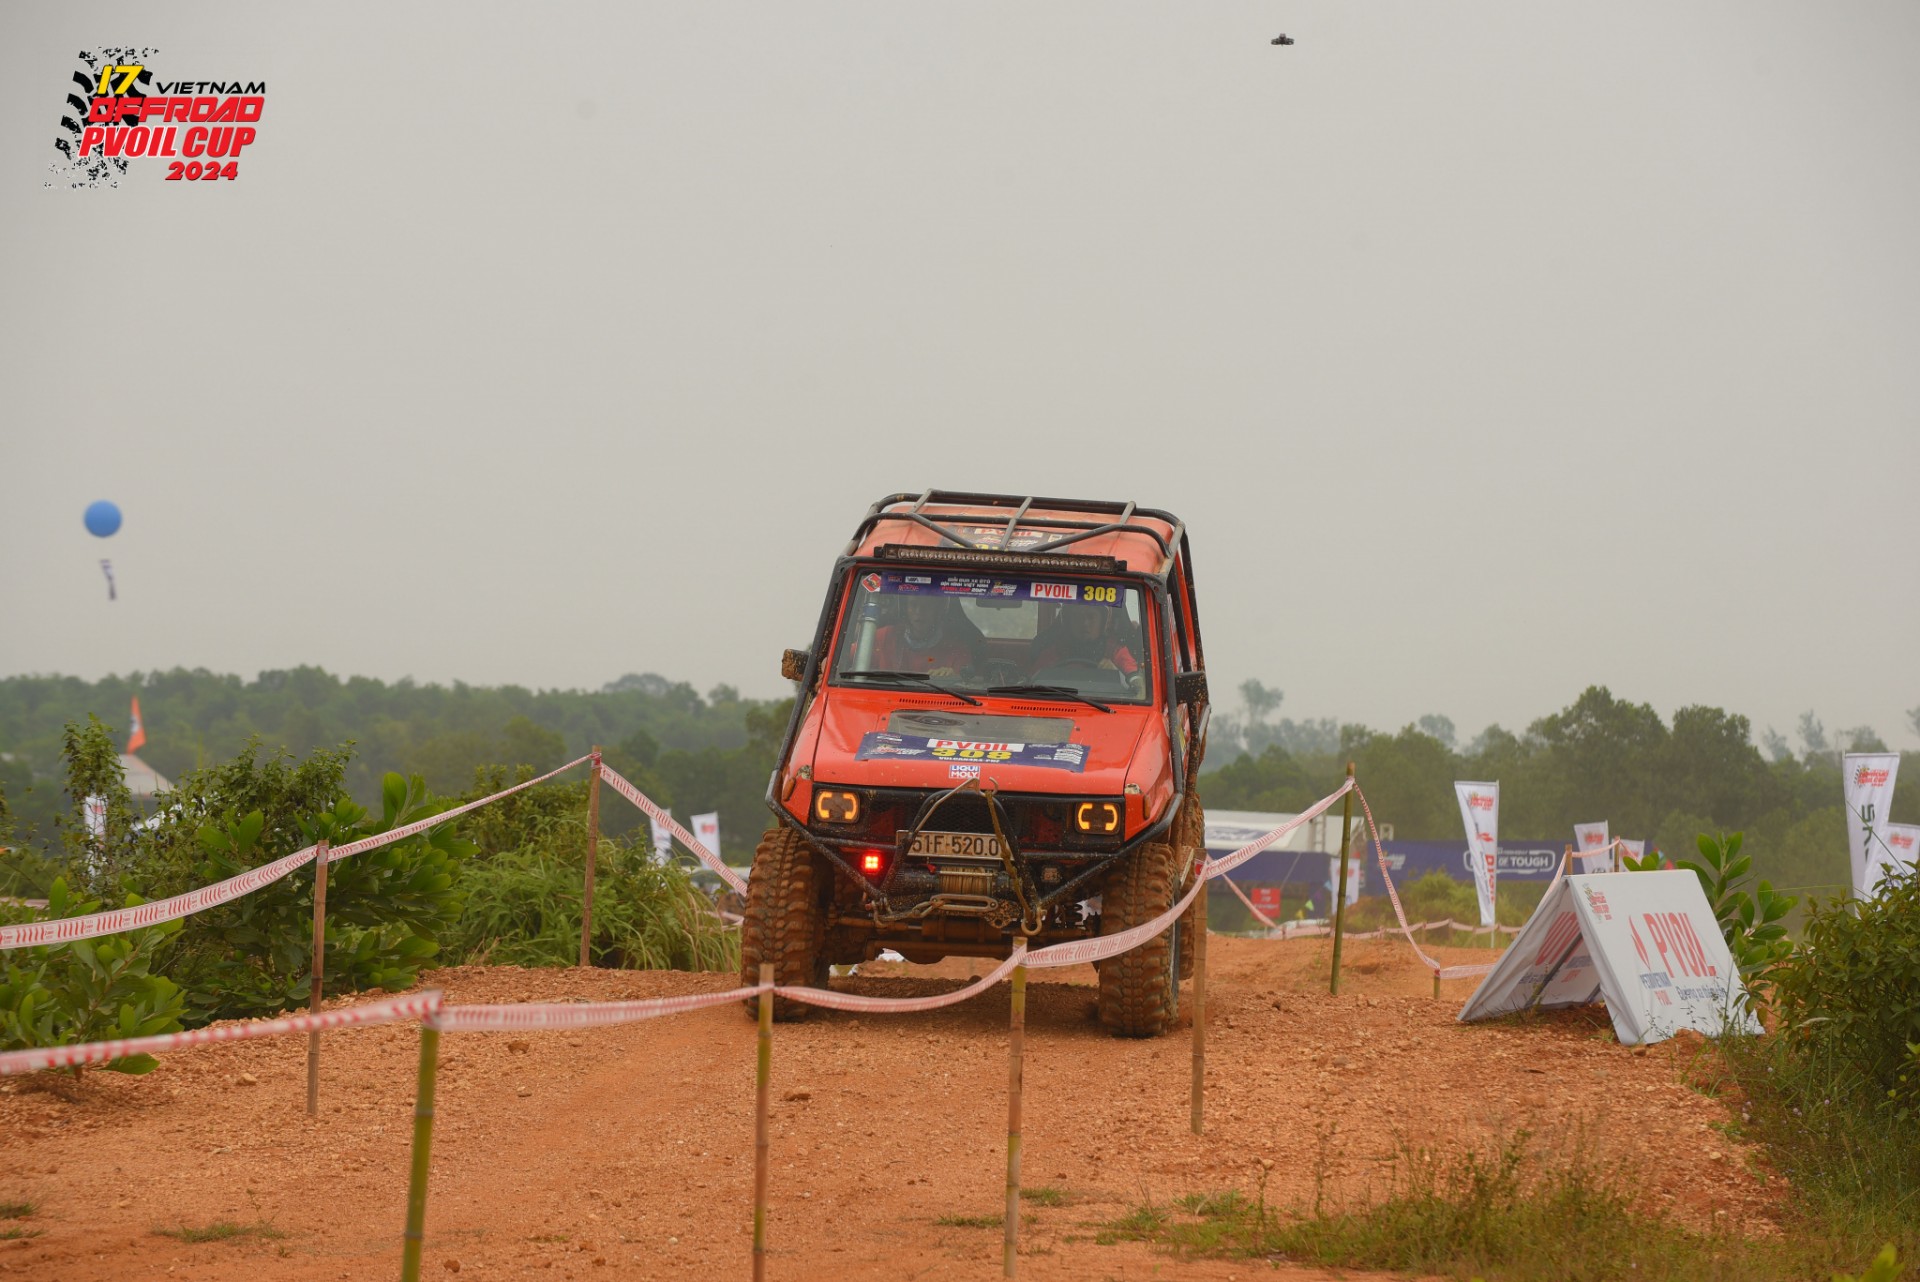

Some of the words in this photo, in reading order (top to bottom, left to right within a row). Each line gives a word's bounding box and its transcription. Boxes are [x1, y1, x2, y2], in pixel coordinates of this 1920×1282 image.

[1034, 583, 1073, 599] PVOIL
[1083, 585, 1117, 602] 308
[935, 740, 1013, 752] PVOIL
[932, 748, 1012, 760] 308
[1510, 856, 1548, 867] TOUGH
[1643, 912, 1716, 978] PVOIL
